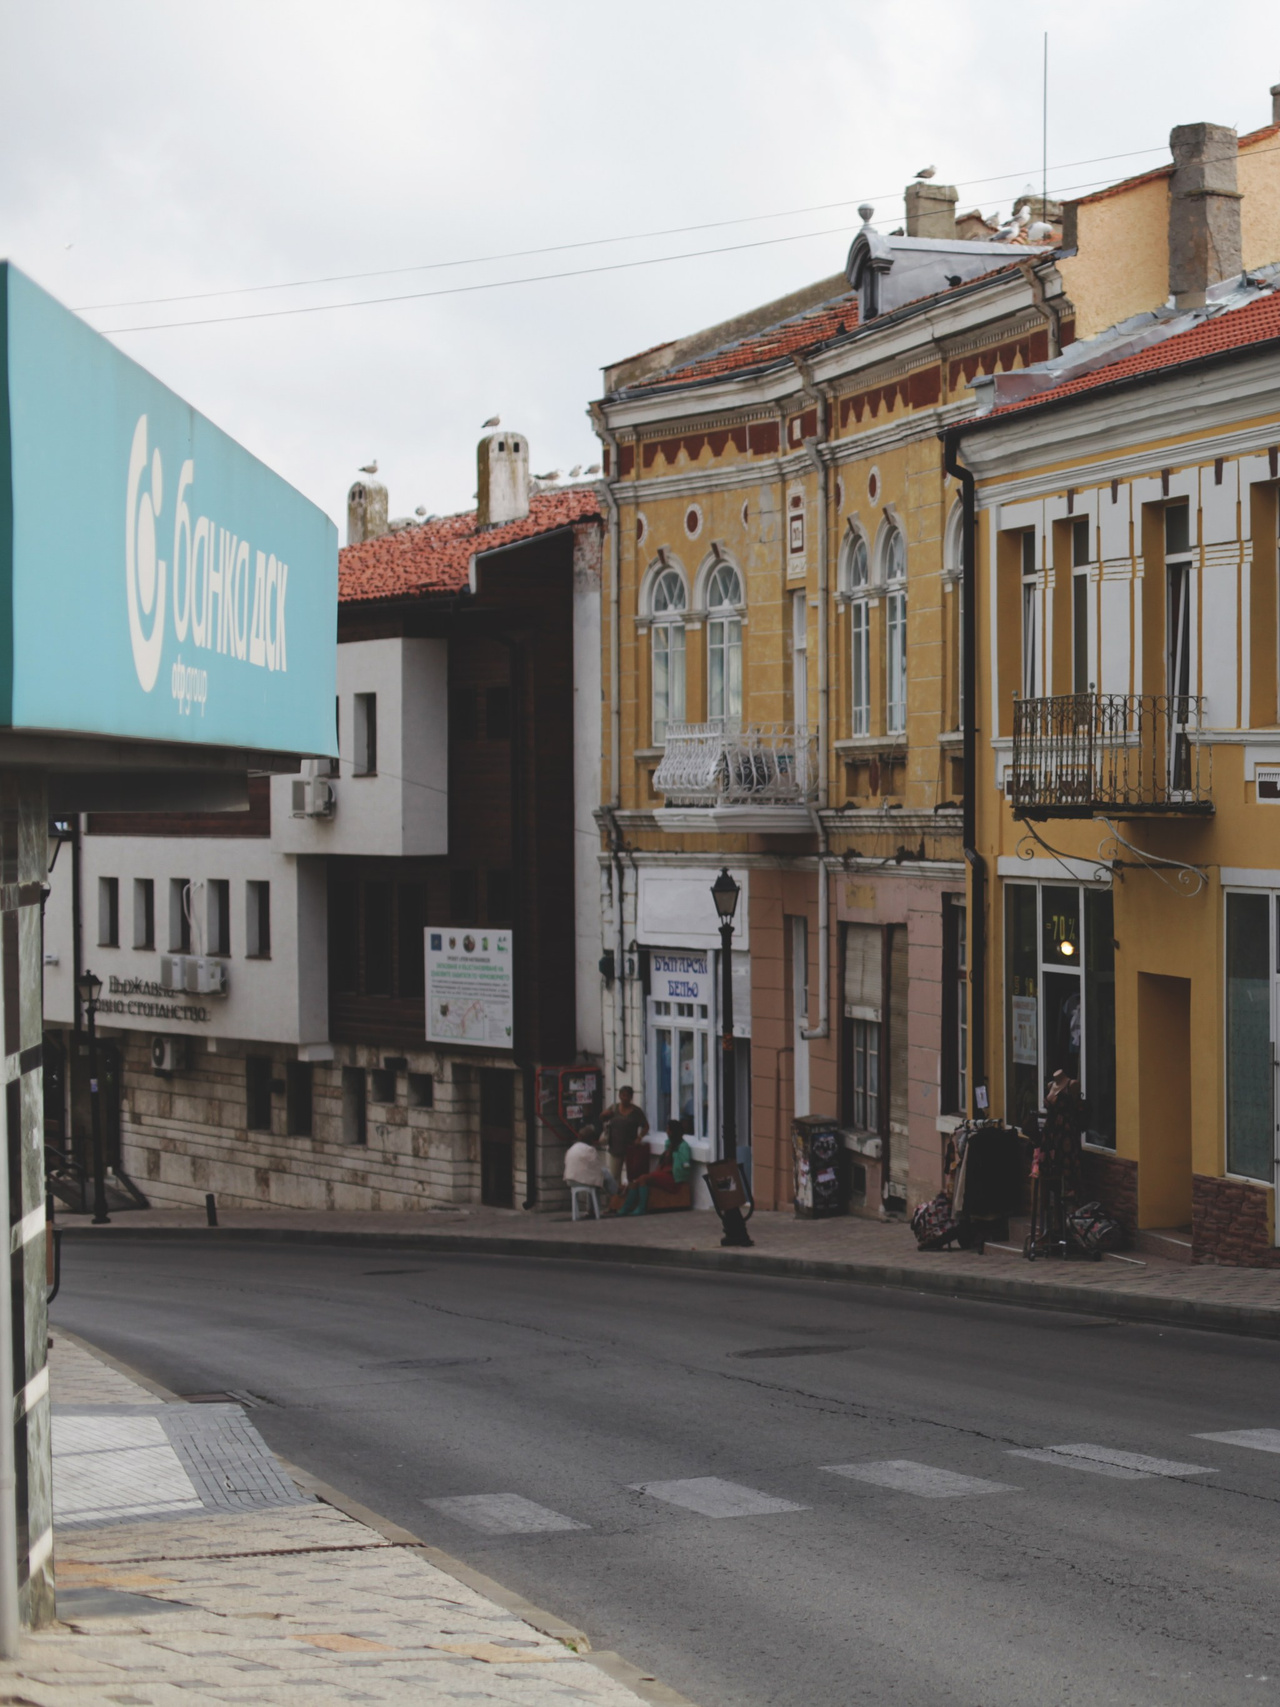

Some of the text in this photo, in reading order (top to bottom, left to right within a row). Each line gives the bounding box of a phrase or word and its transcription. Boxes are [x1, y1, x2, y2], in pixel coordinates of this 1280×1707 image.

[173, 458, 250, 662] банка
[172, 653, 208, 717] otp group
[668, 980, 699, 998] БЕЛЬО
